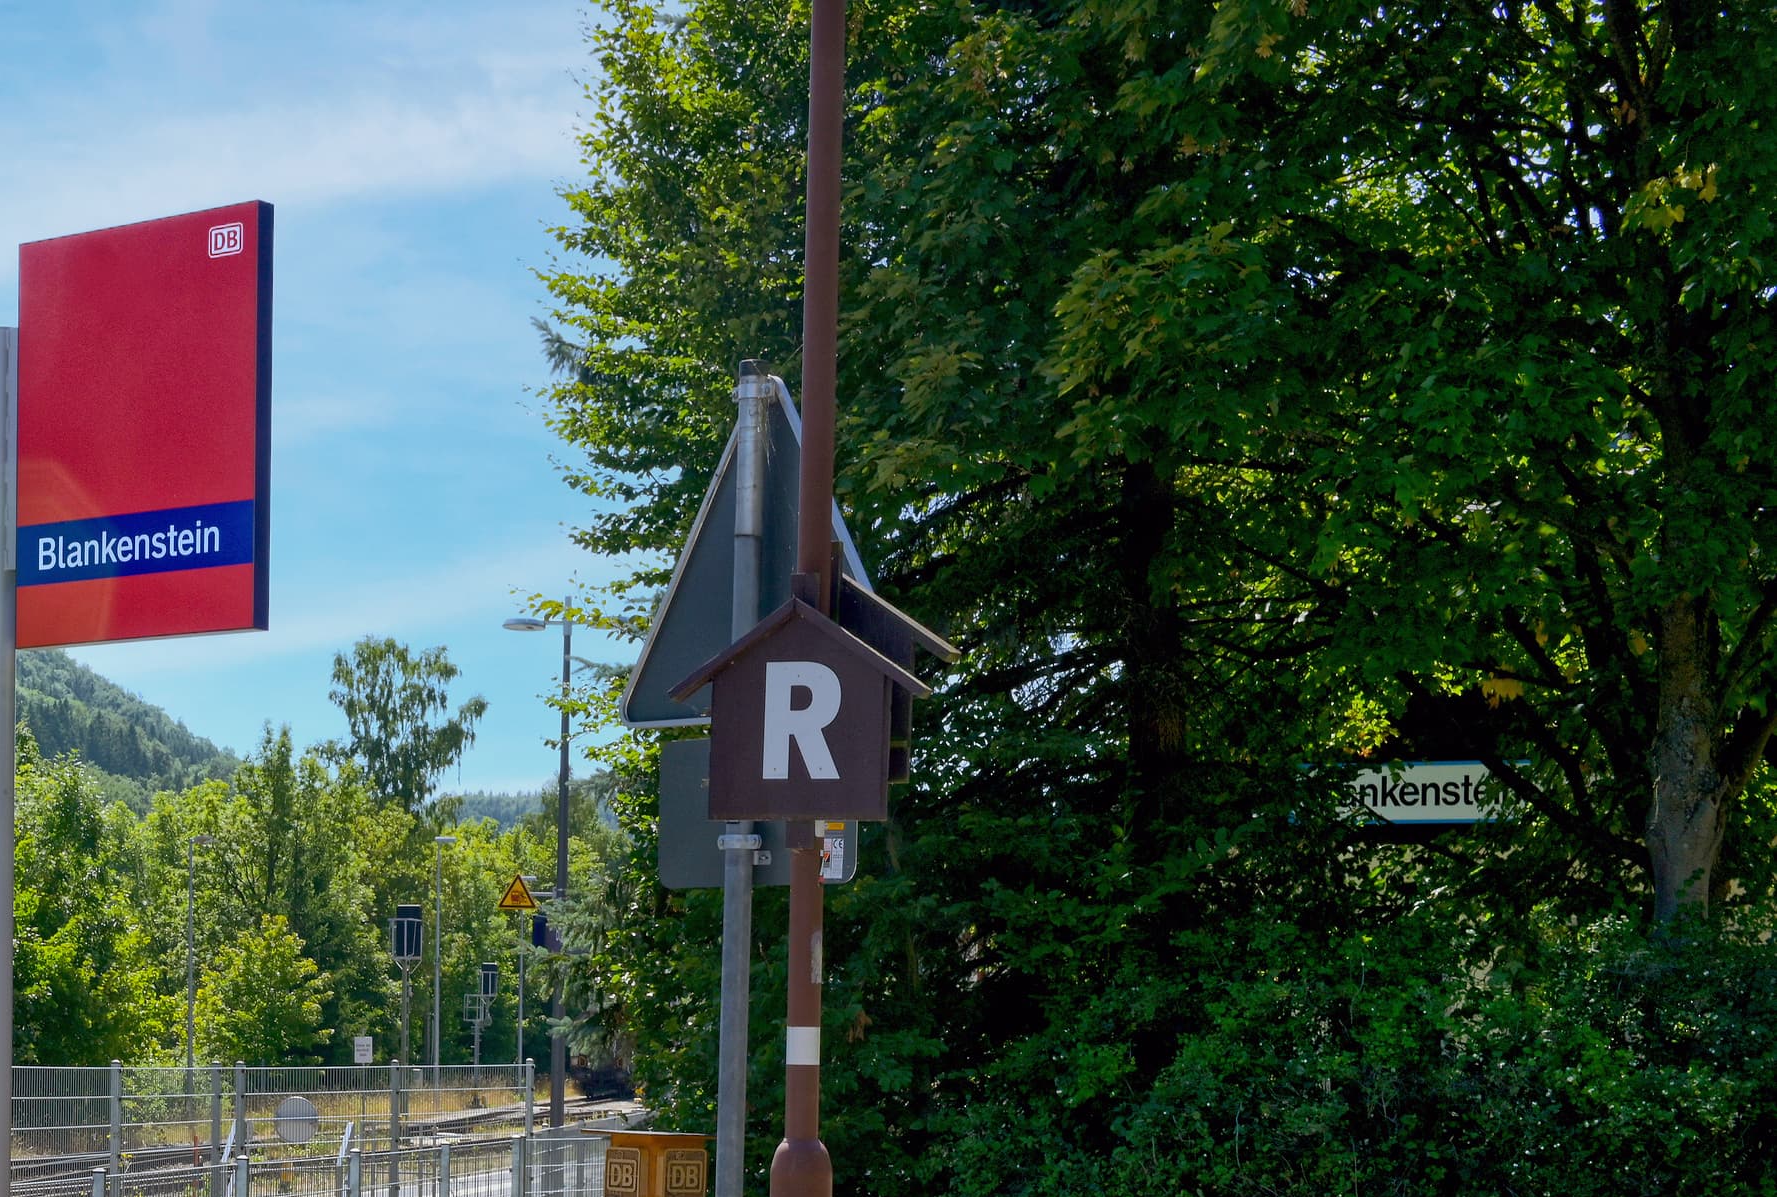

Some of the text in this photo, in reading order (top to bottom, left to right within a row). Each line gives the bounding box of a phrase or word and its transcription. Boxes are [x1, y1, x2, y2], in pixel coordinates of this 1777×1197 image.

[214, 230, 238, 251] DB
[38, 520, 220, 571] Blankenstein
[762, 661, 842, 780] R
[610, 1163, 633, 1187] DB
[671, 1165, 699, 1189] DB
